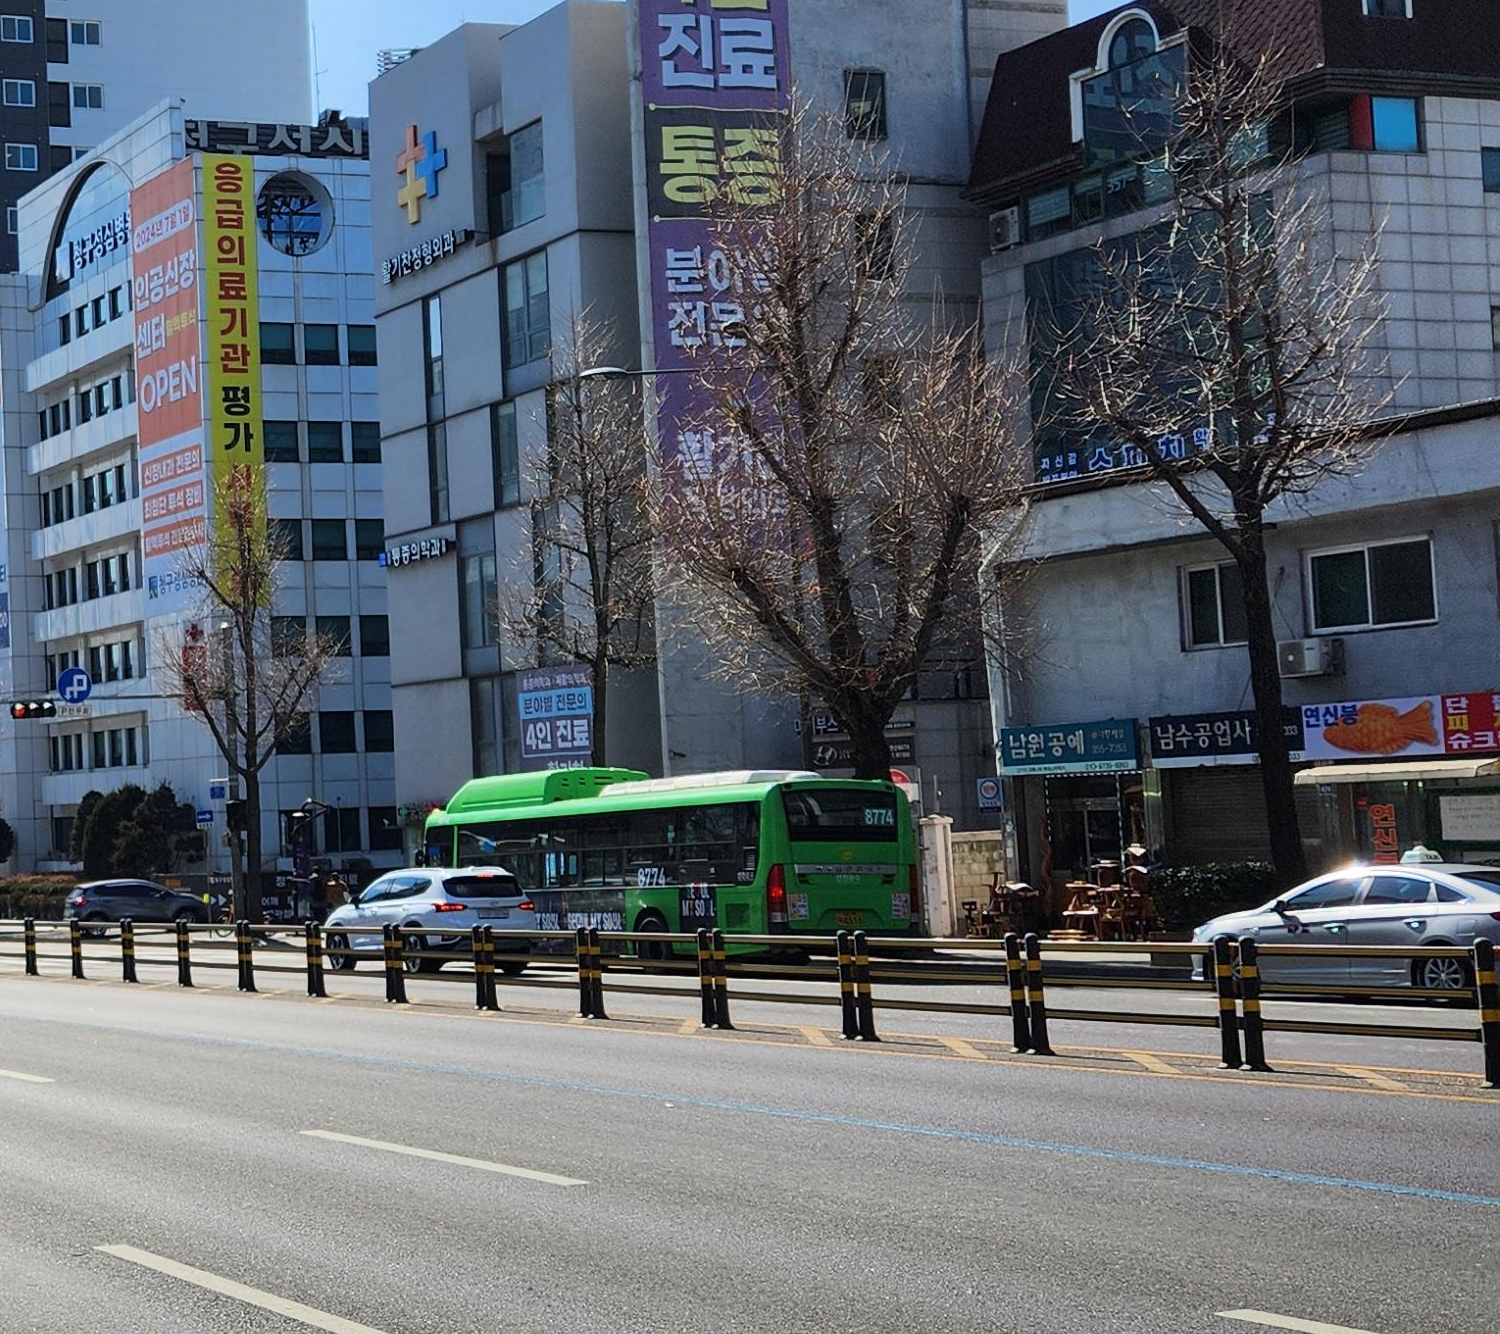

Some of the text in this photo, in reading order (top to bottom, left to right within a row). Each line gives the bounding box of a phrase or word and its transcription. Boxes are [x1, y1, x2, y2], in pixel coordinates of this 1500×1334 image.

[658, 14, 777, 88] 진료
[660, 126, 781, 205] 통증
[136, 249, 196, 312] 인공신장
[214, 162, 251, 374] 응급의료기관
[381, 230, 454, 285] 활기찬정형외과
[137, 313, 165, 359] 센터
[140, 356, 197, 413] OPEN
[526, 719, 589, 750] 4인 진료
[1156, 719, 1251, 750] 남수공업사
[1449, 731, 1500, 750] 슈크
[865, 809, 894, 825] 8774
[637, 867, 666, 886] 8774
